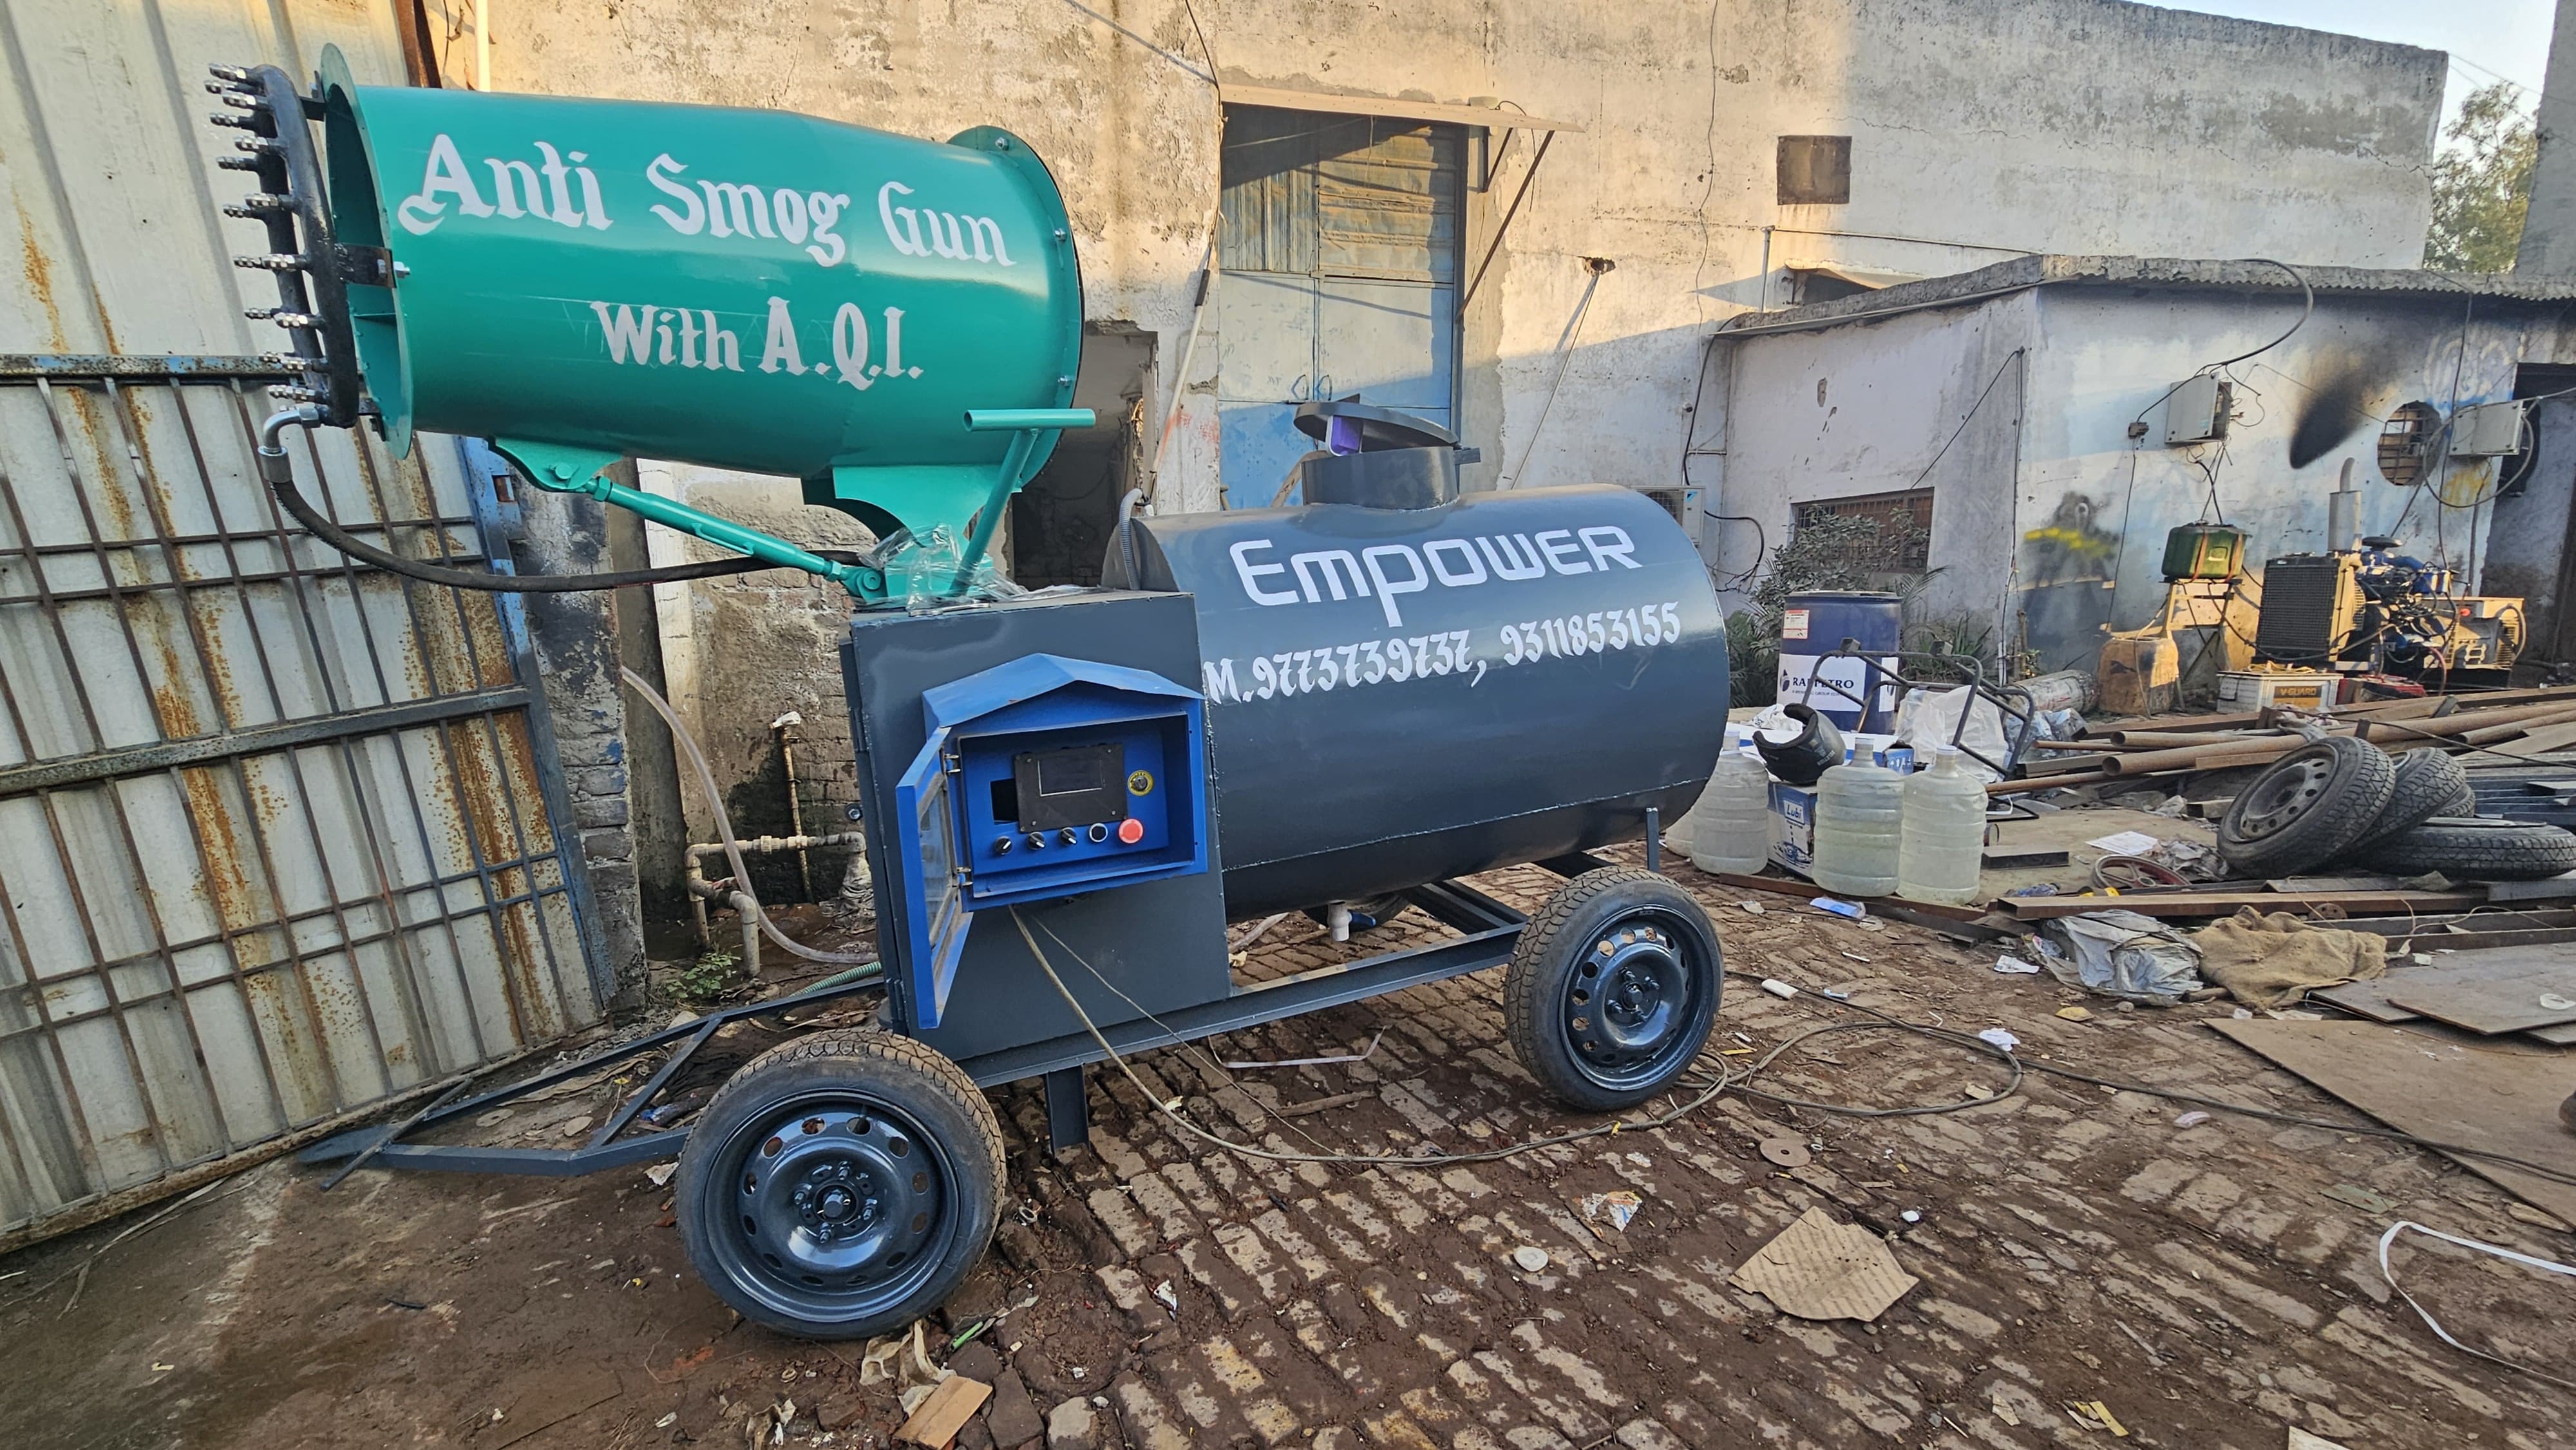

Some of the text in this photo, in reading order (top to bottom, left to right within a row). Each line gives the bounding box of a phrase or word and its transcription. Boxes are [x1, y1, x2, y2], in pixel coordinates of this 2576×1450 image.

[397, 133, 1017, 267] Anti Smog Gun
[590, 296, 923, 390] With A.Q.I.
[1501, 601, 1681, 666] 9311853155
[1787, 804, 1803, 820] Lubi
